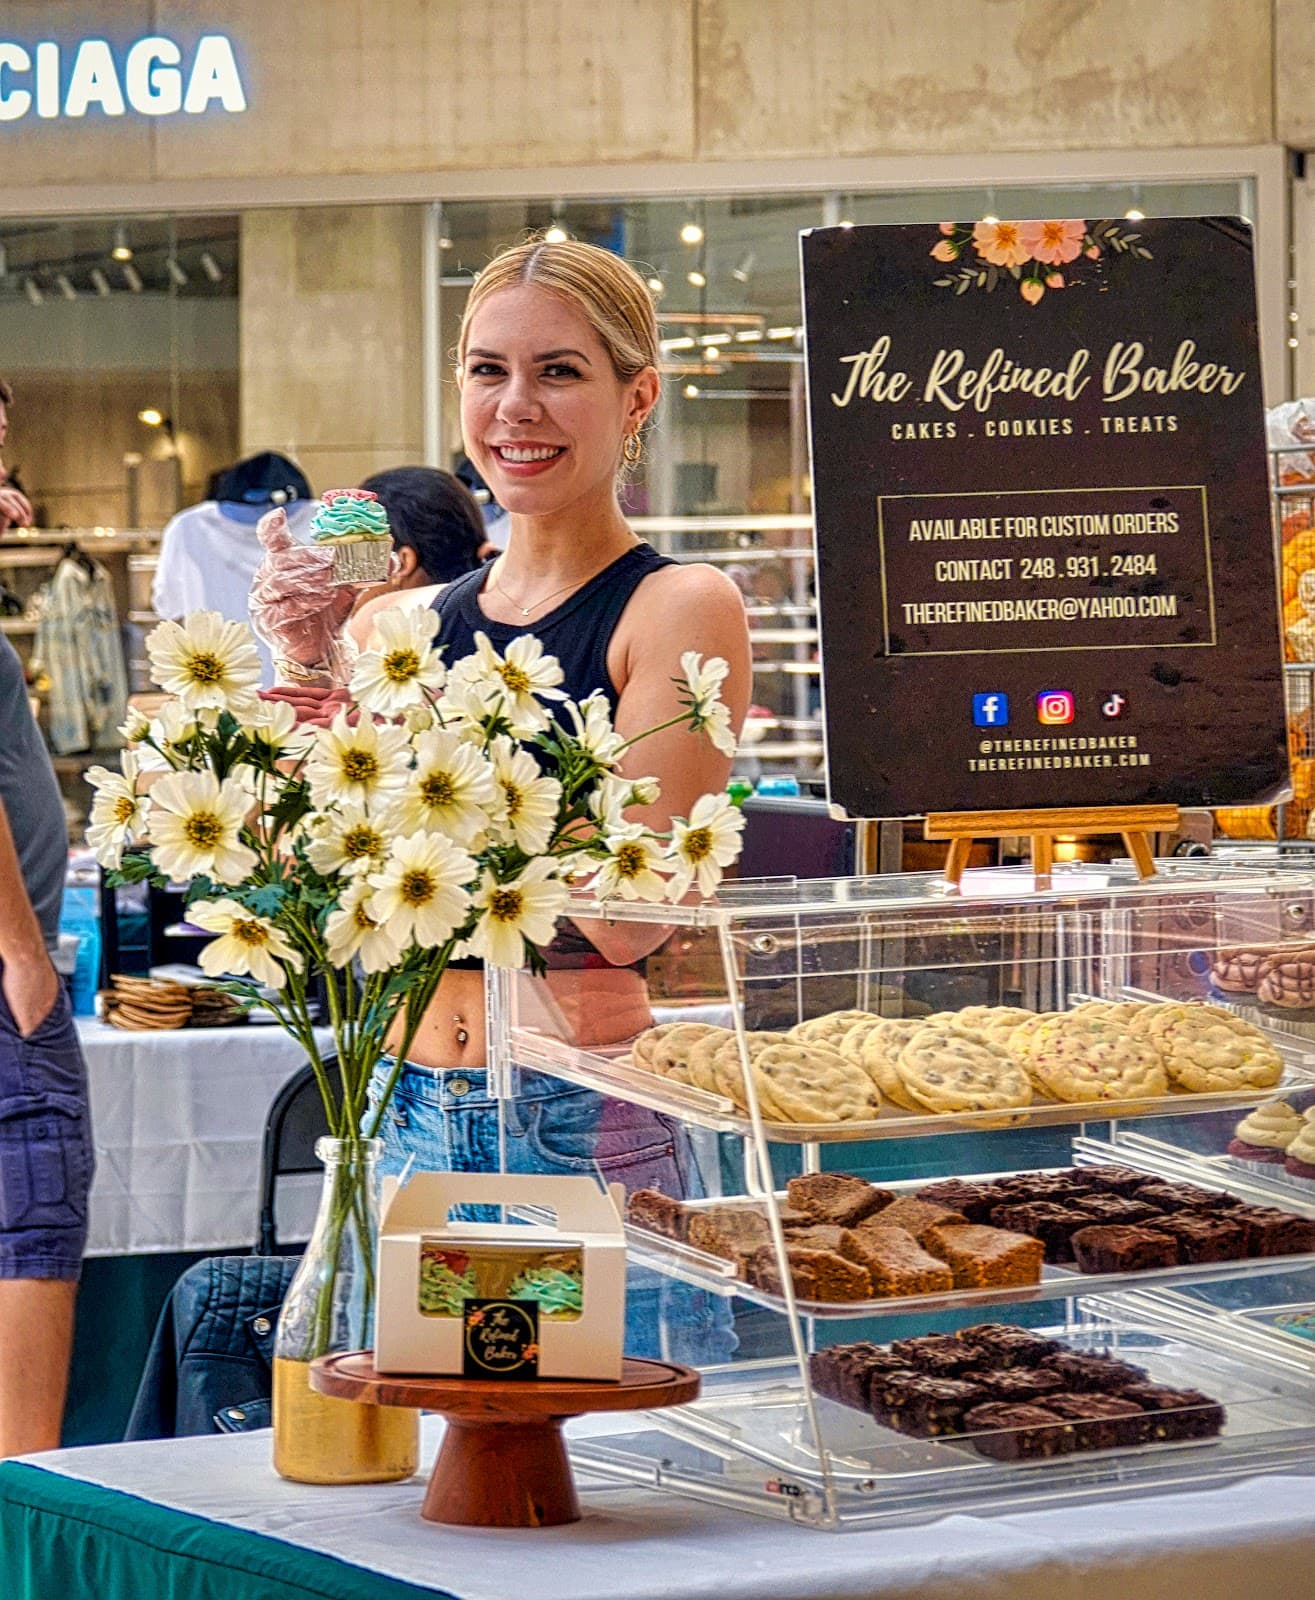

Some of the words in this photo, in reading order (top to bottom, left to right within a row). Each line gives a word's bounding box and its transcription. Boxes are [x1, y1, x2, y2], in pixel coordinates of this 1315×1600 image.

[0, 35, 247, 121] CIAGA
[831, 335, 913, 407] The
[923, 348, 1092, 412] Refined
[1101, 339, 1246, 402] Baker
[891, 422, 957, 441] CAKES
[985, 418, 1074, 438] COOKIES
[1101, 415, 1179, 435] TREATS
[908, 518, 1002, 541] AVAILABLE
[1004, 517, 1039, 538] FOR
[1041, 515, 1111, 538] CUSTOM
[1113, 512, 1180, 535] ORDERS
[935, 558, 1014, 582] CONTACT
[901, 595, 1178, 625] THEREFINEDBAKER@YAHOO.COM
[979, 736, 1138, 754] @THEREFINEDBAKER
[968, 753, 1151, 772] THEREFINEDBAKER.COM
